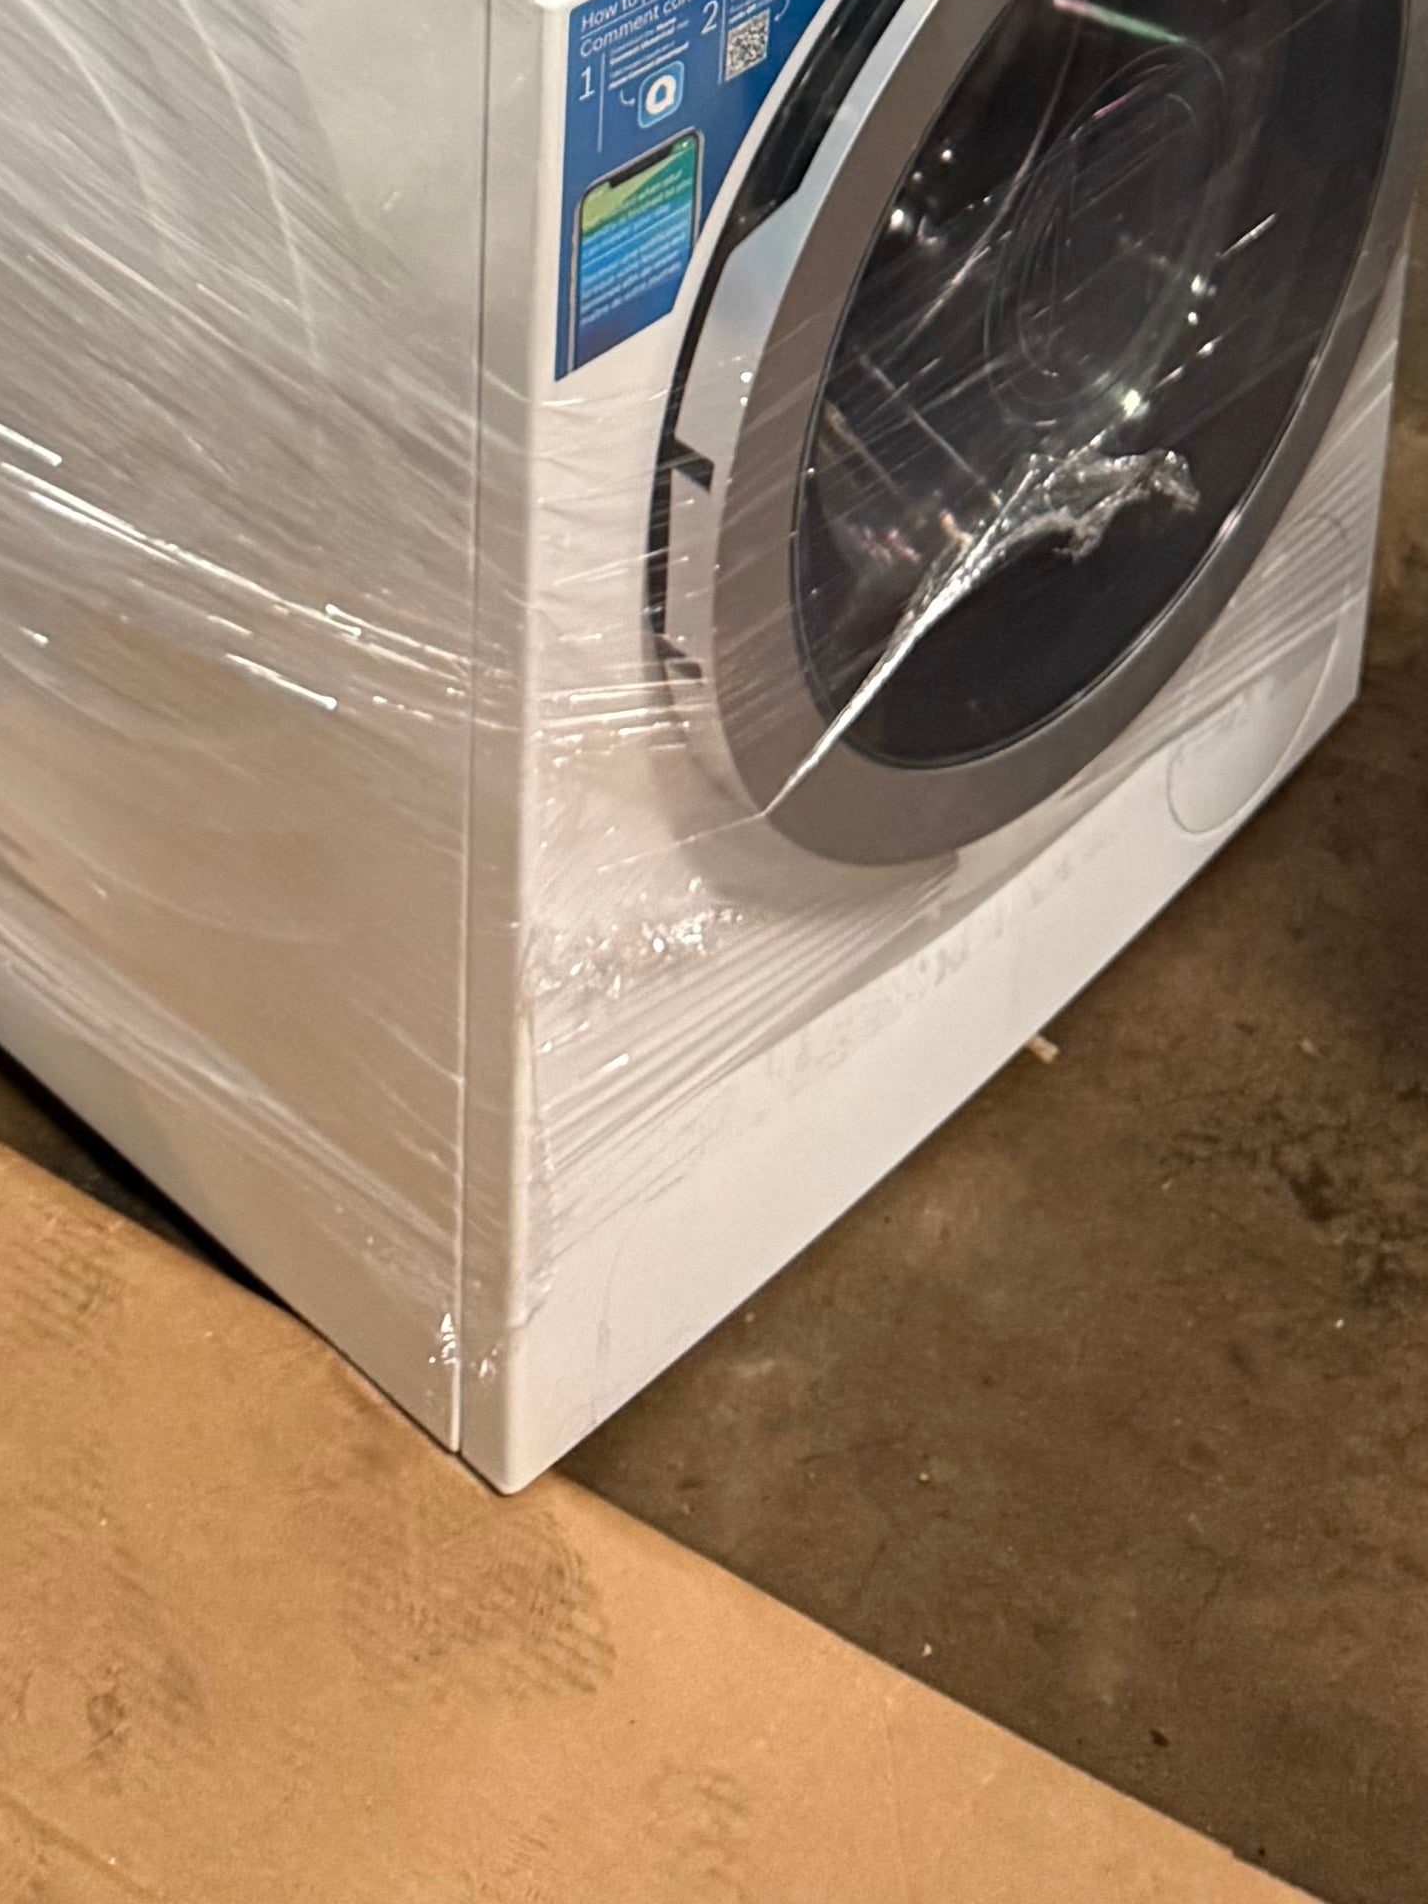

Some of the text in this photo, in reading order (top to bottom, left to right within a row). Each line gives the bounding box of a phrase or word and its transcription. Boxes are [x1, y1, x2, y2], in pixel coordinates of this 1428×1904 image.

[579, 4, 661, 58] Comment
[580, 0, 619, 34] How
[700, 0, 719, 36] 2
[578, 65, 596, 102] 1
